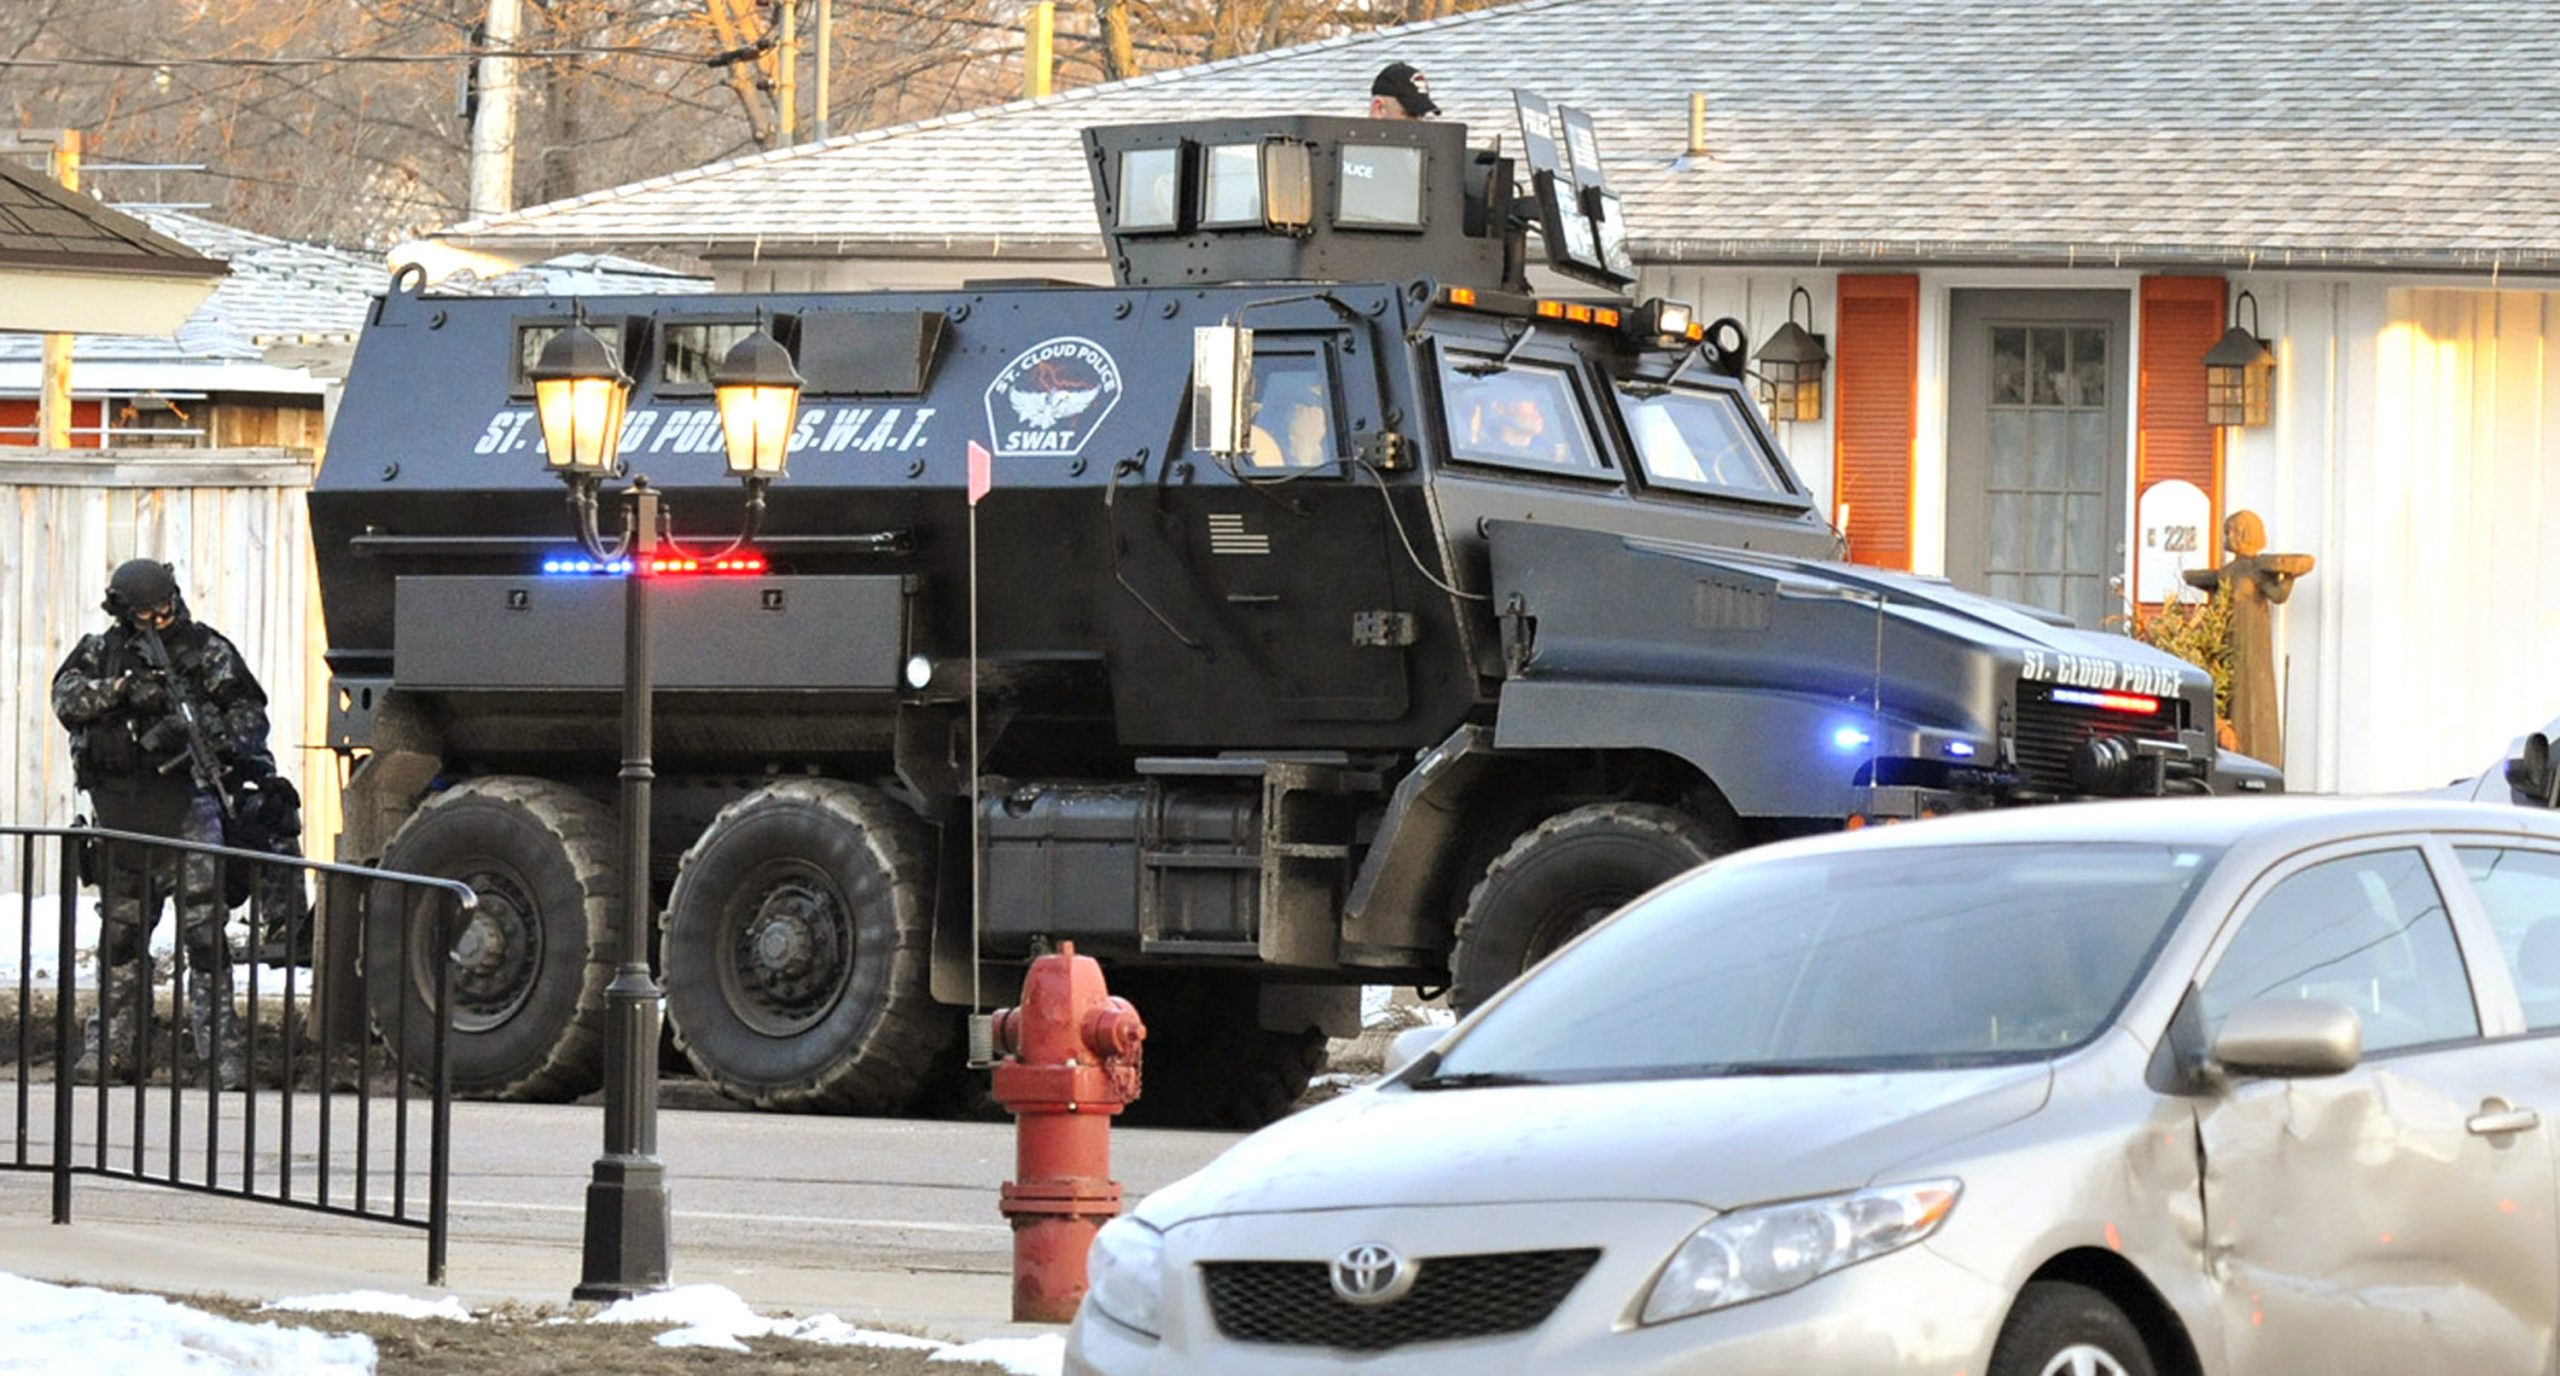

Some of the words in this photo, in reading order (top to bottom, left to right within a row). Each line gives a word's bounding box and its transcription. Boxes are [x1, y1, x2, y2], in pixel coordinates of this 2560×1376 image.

[1343, 160, 1374, 179] LICE
[995, 369, 1021, 395] ST.
[1020, 343, 1077, 371] CLOUD
[1076, 346, 1116, 393] POLICE
[473, 411, 535, 454] ST.
[648, 410, 725, 454] POLI
[786, 408, 936, 453] S.W.A.T.
[1004, 430, 1076, 451] SWAT
[2021, 650, 2051, 681] ST.
[2056, 653, 2118, 690] CLOUD
[2119, 662, 2183, 699] POLICE
